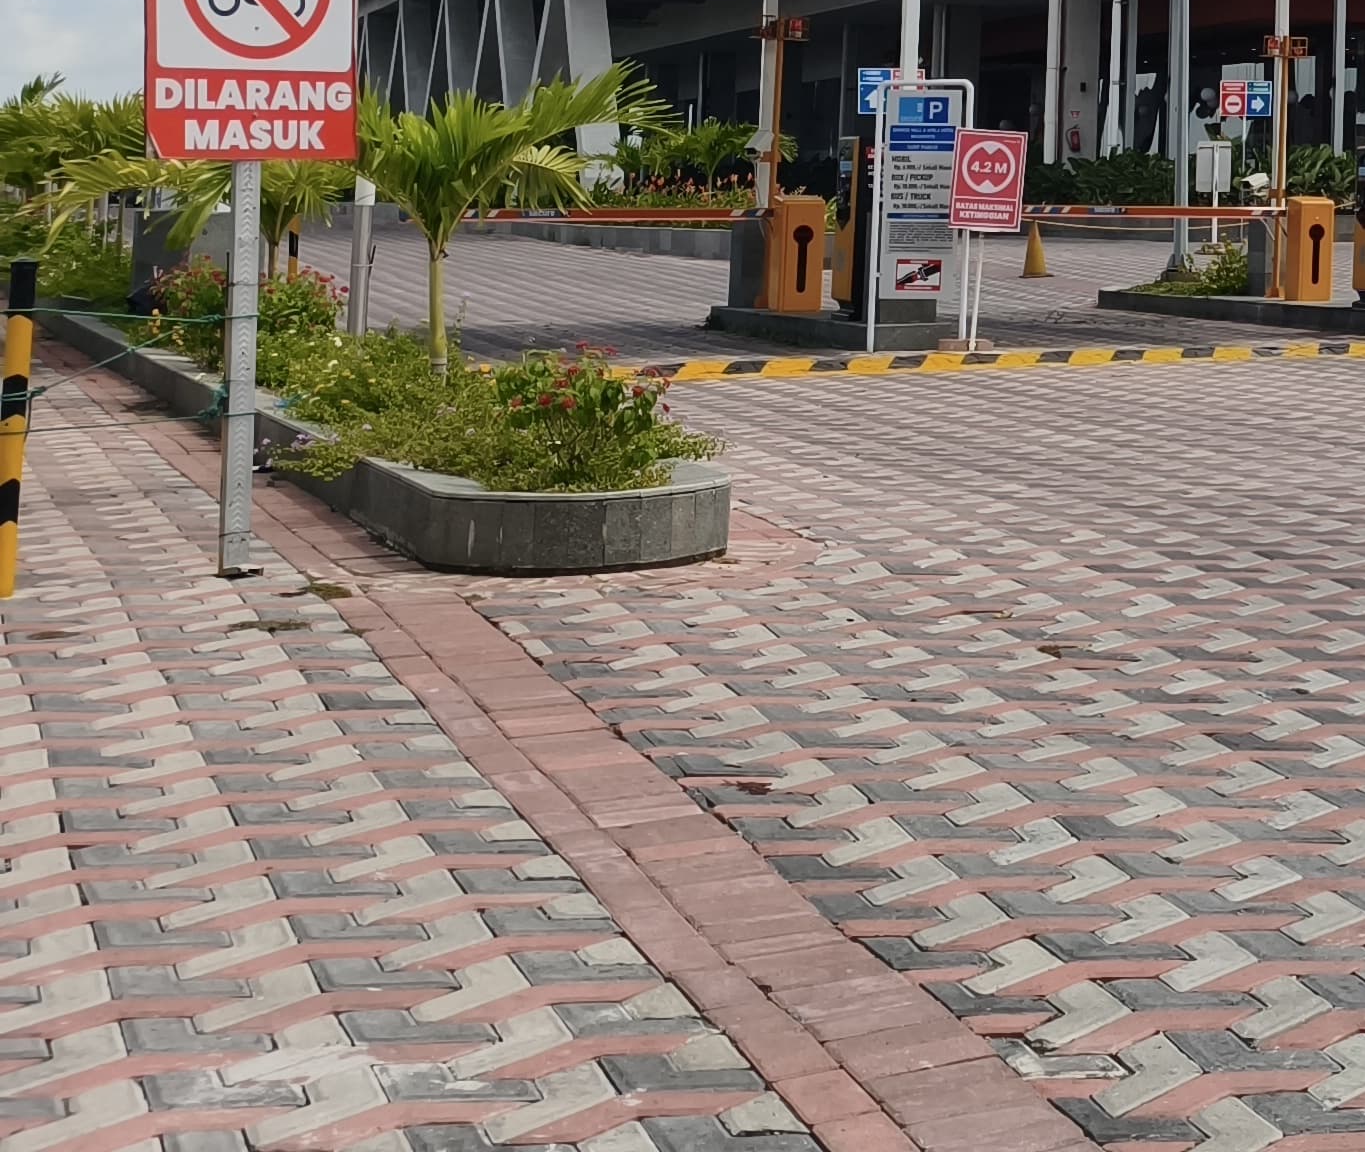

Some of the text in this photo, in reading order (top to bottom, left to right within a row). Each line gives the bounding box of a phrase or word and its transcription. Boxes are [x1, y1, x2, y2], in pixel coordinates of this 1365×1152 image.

[155, 78, 352, 111] DILARANG
[929, 101, 943, 120] P
[184, 119, 325, 151] MASUK
[970, 160, 1008, 175] 4.2 M
[910, 192, 932, 201] TRUCK
